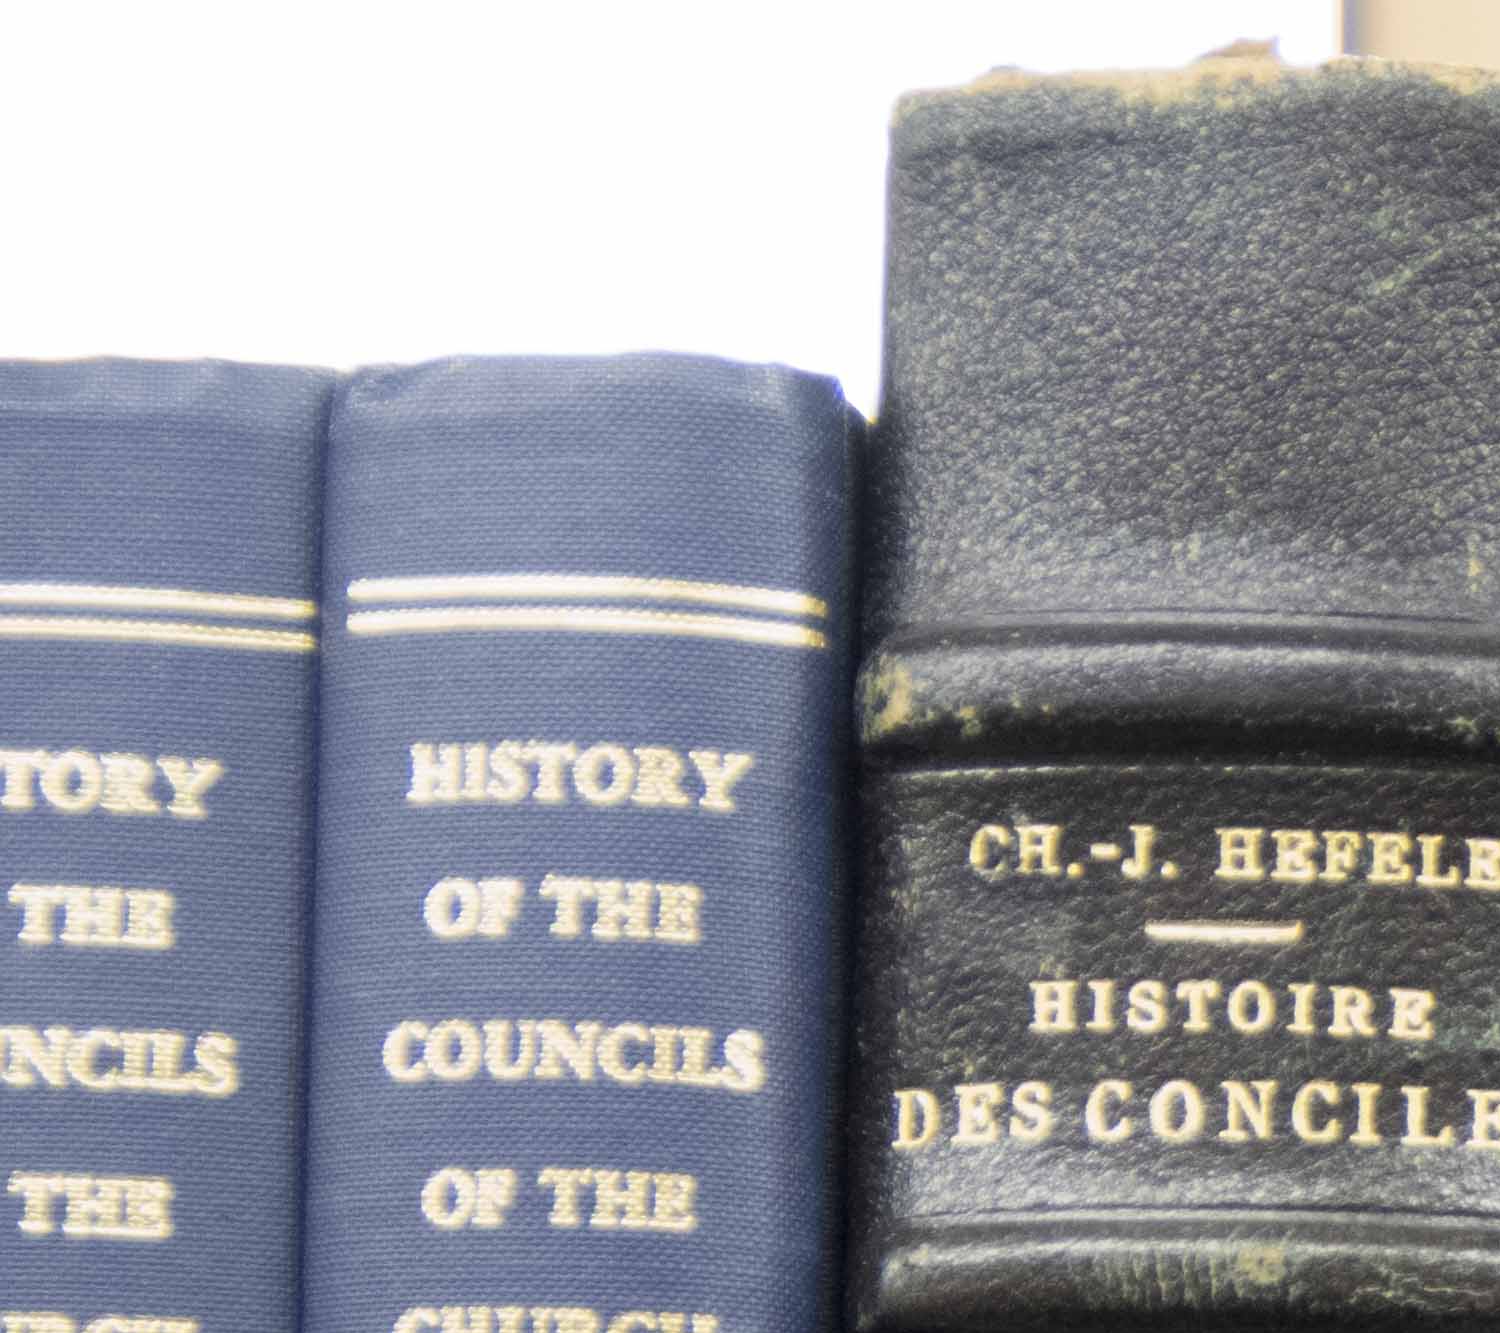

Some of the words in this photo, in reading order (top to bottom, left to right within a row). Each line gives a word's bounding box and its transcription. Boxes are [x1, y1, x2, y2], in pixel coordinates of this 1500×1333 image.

[404, 739, 756, 813] HISTORY
[967, 823, 1179, 881] CH.-J.
[7, 882, 177, 950] THE
[422, 875, 524, 943] OF
[536, 873, 704, 945] THE
[1029, 980, 1436, 1041] HISTOIRE
[381, 1019, 768, 1093] COUNCILS
[892, 1080, 1053, 1150] DES
[7, 1171, 176, 1240] THE
[419, 1166, 517, 1231] OF
[536, 1166, 700, 1234] THE
